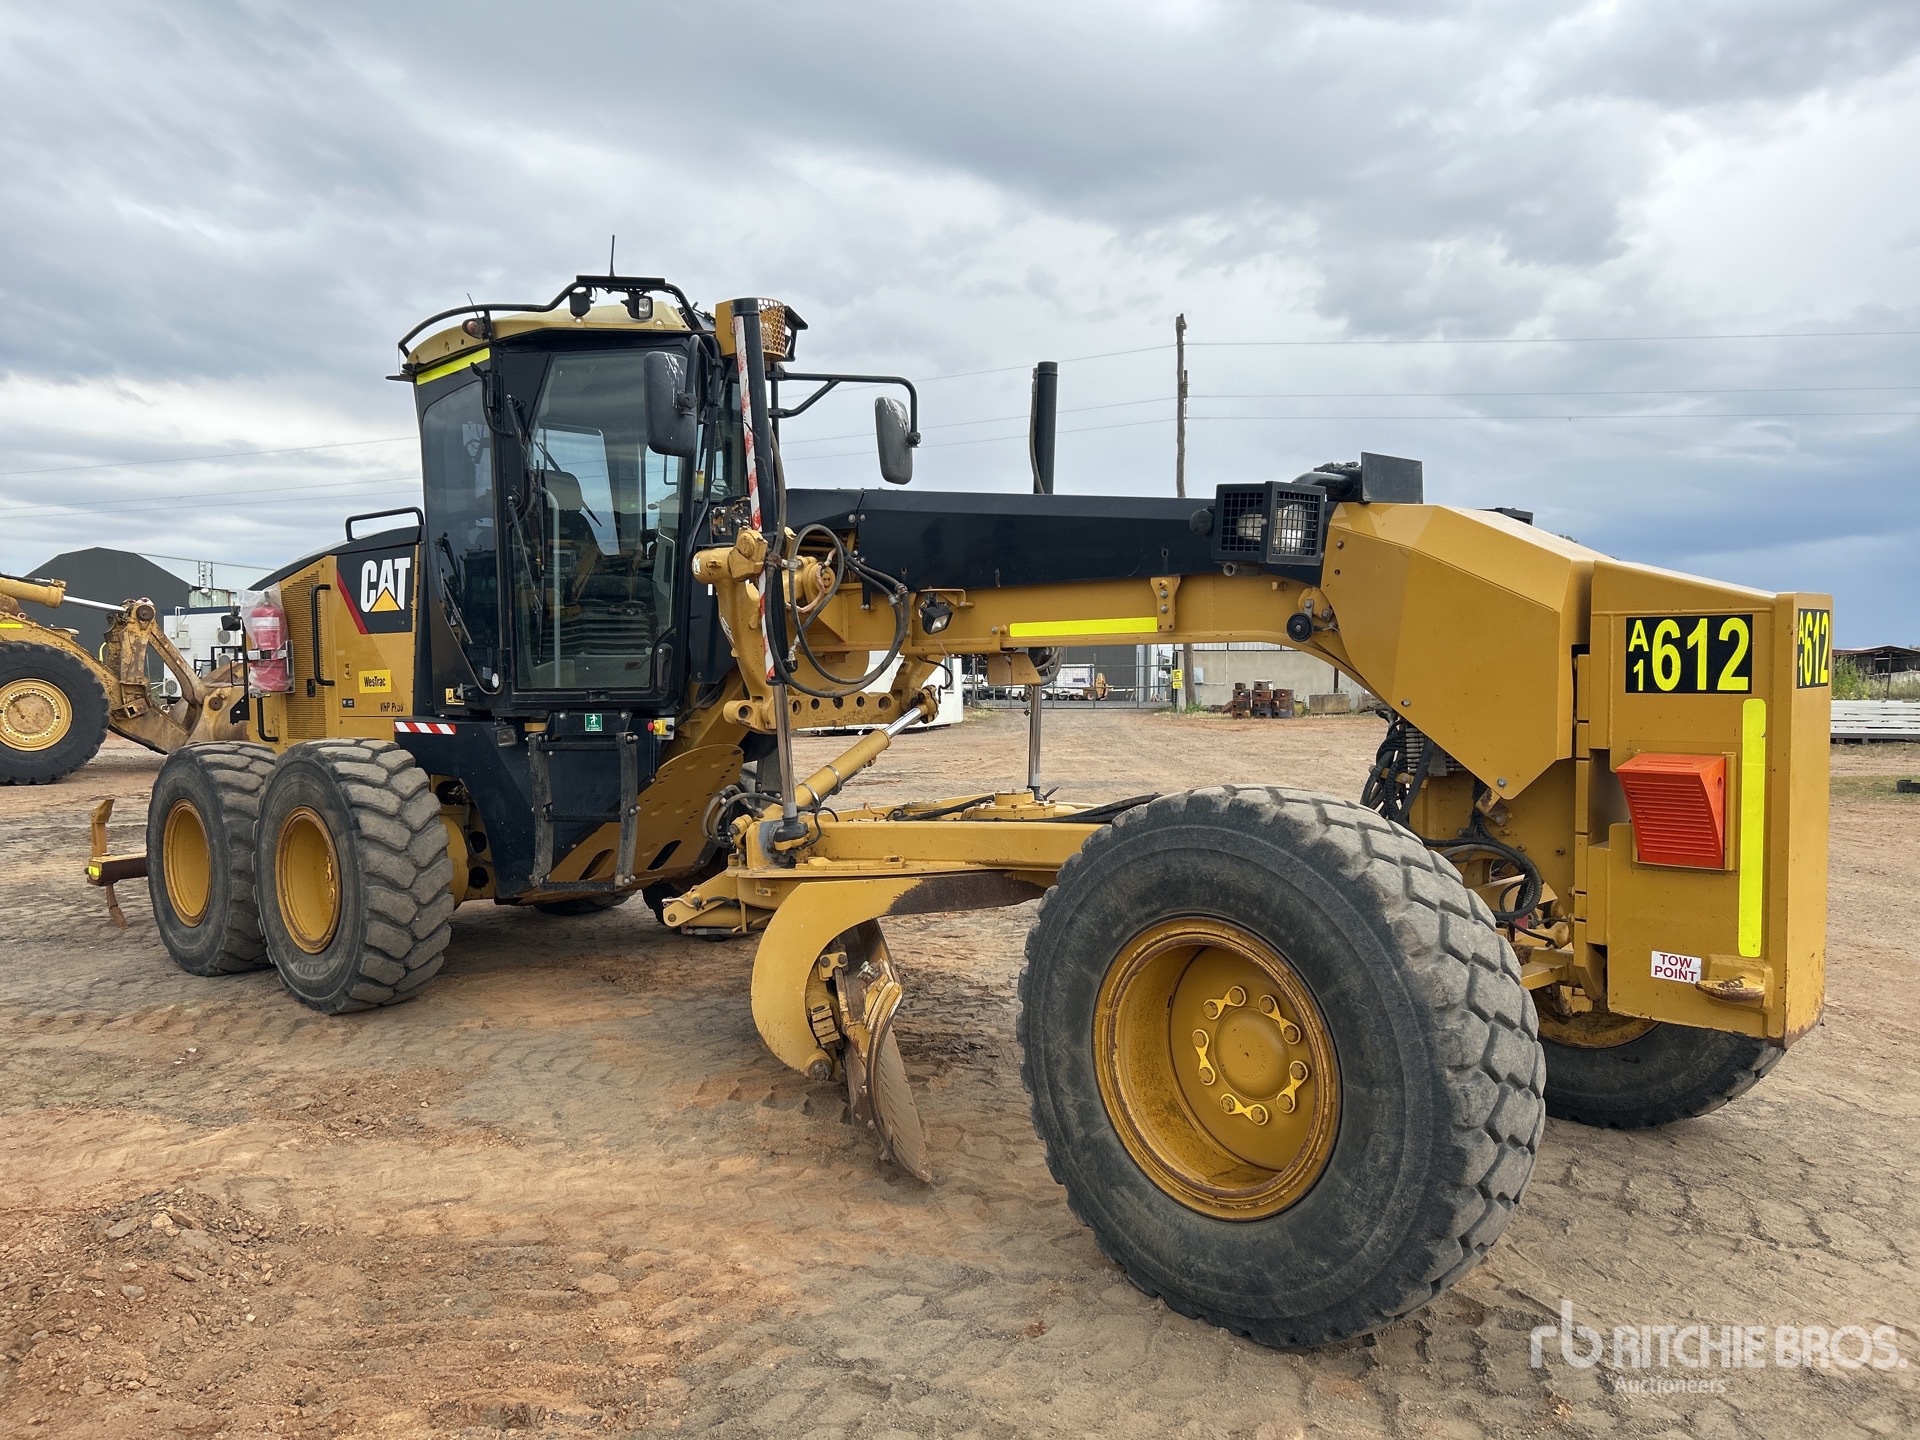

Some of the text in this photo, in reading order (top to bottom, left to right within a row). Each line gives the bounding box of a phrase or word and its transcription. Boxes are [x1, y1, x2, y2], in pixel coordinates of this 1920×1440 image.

[360, 557, 411, 613] CAT
[1628, 620, 1650, 652] A
[1804, 611, 1830, 686] 612
[1652, 617, 1750, 692] 612
[363, 676, 387, 688] WesTrac
[1633, 659, 1644, 692] 1
[1654, 966, 1697, 981] POINT
[1660, 954, 1692, 968] TOW
